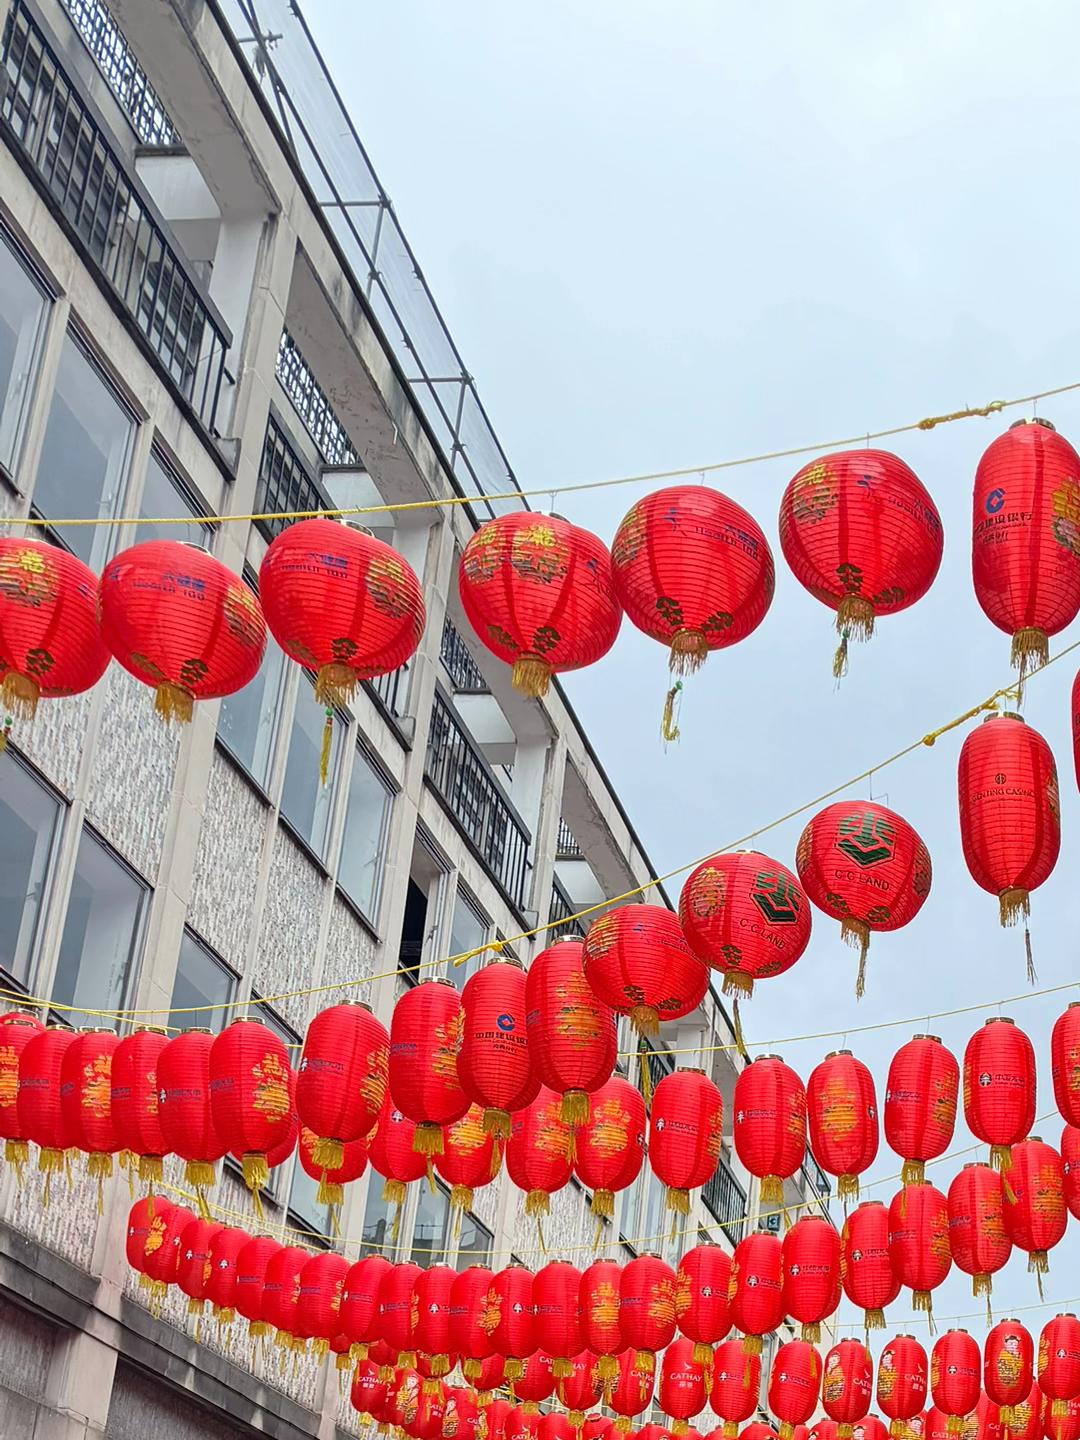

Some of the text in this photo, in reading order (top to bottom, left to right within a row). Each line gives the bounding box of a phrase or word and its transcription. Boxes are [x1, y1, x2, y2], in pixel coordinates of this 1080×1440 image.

[859, 873, 891, 891] LAND
[761, 928, 787, 950] LAND
[670, 1372, 702, 1382] CATHAY
